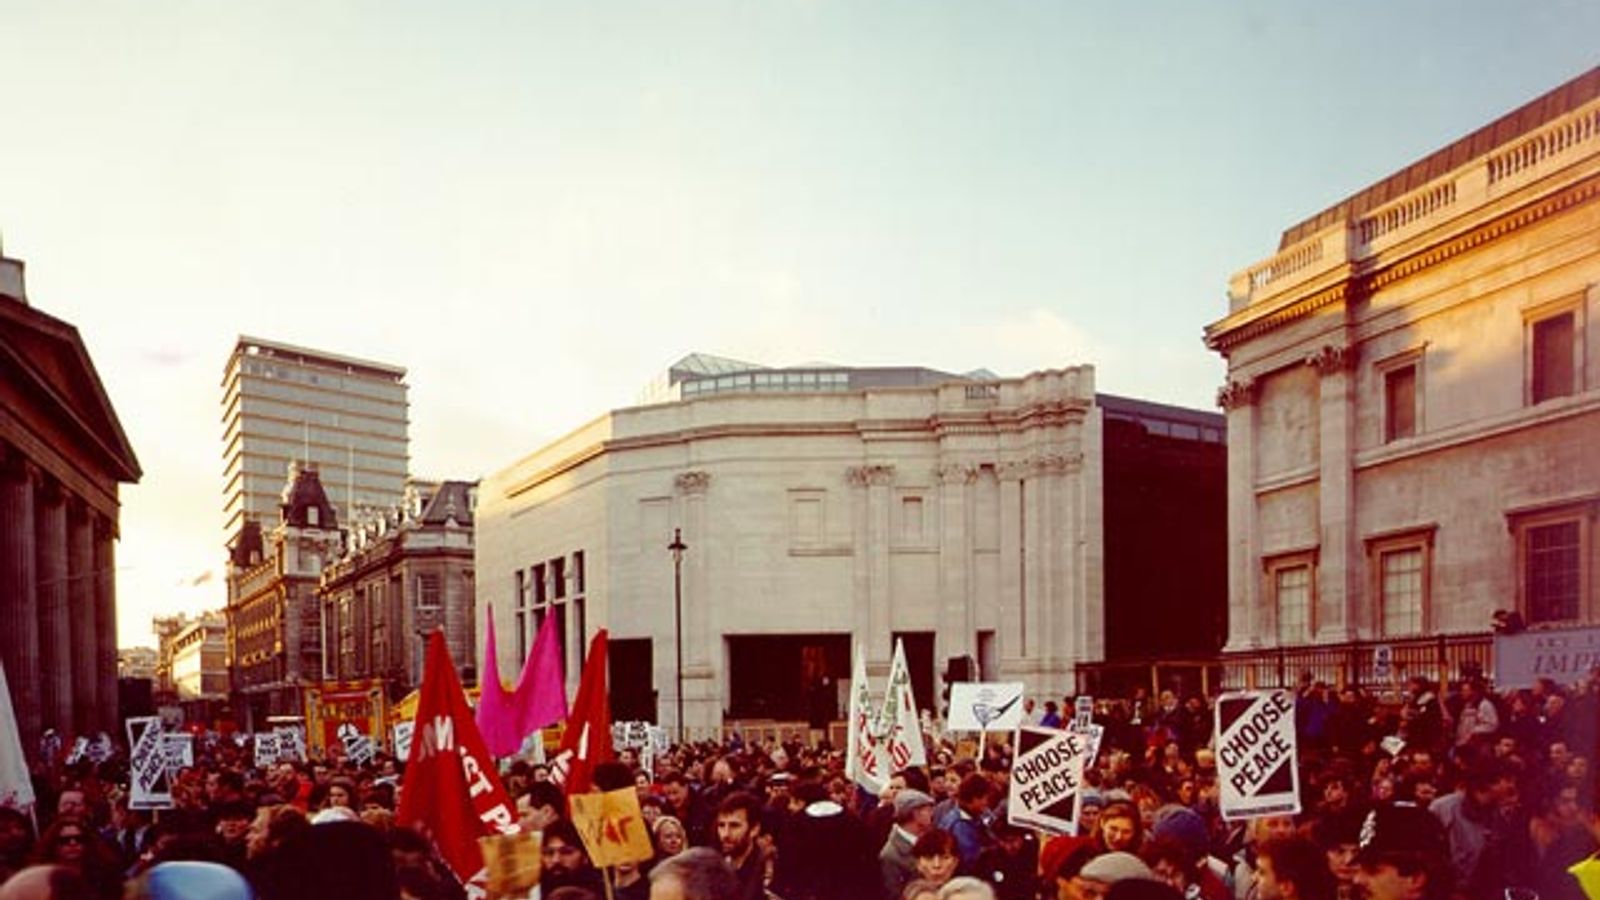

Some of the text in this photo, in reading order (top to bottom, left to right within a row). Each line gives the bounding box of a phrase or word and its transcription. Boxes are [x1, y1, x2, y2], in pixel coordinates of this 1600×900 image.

[1220, 691, 1292, 768] CHOOSE
[1014, 736, 1083, 785] CHOOSE
[1230, 731, 1292, 797] PEACE
[1020, 769, 1078, 810] PEACE
